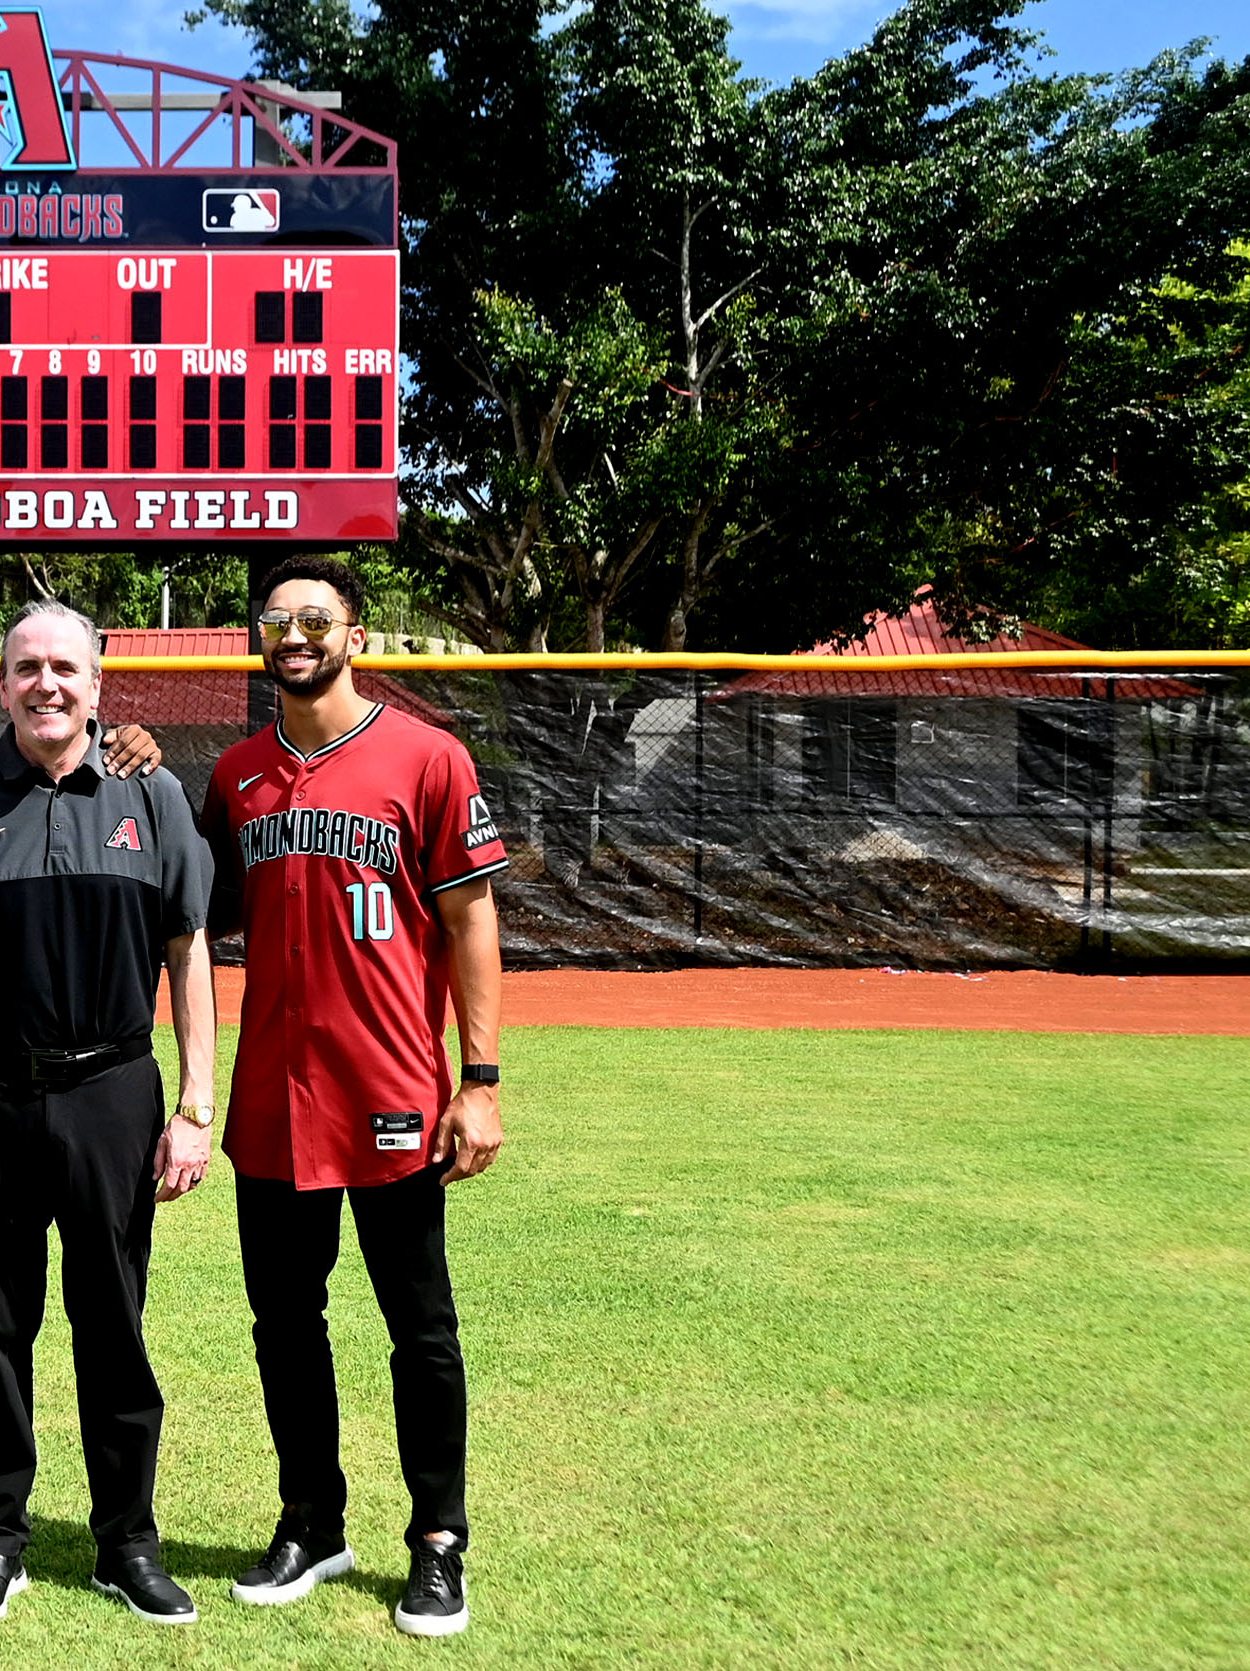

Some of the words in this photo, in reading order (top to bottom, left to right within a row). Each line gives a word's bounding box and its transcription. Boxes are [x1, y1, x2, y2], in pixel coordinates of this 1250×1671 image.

[117, 258, 177, 290] OUT
[283, 258, 333, 292] H/E
[9, 349, 23, 375] 7
[48, 349, 62, 375] 8
[86, 349, 101, 375] 9
[130, 349, 157, 375] 10
[182, 349, 248, 375] RUNS
[273, 349, 327, 375] HITS
[345, 349, 392, 374] ERR
[134, 490, 299, 529] FIELD
[238, 808, 400, 875] AMONDBACKS
[345, 881, 395, 942] 10
